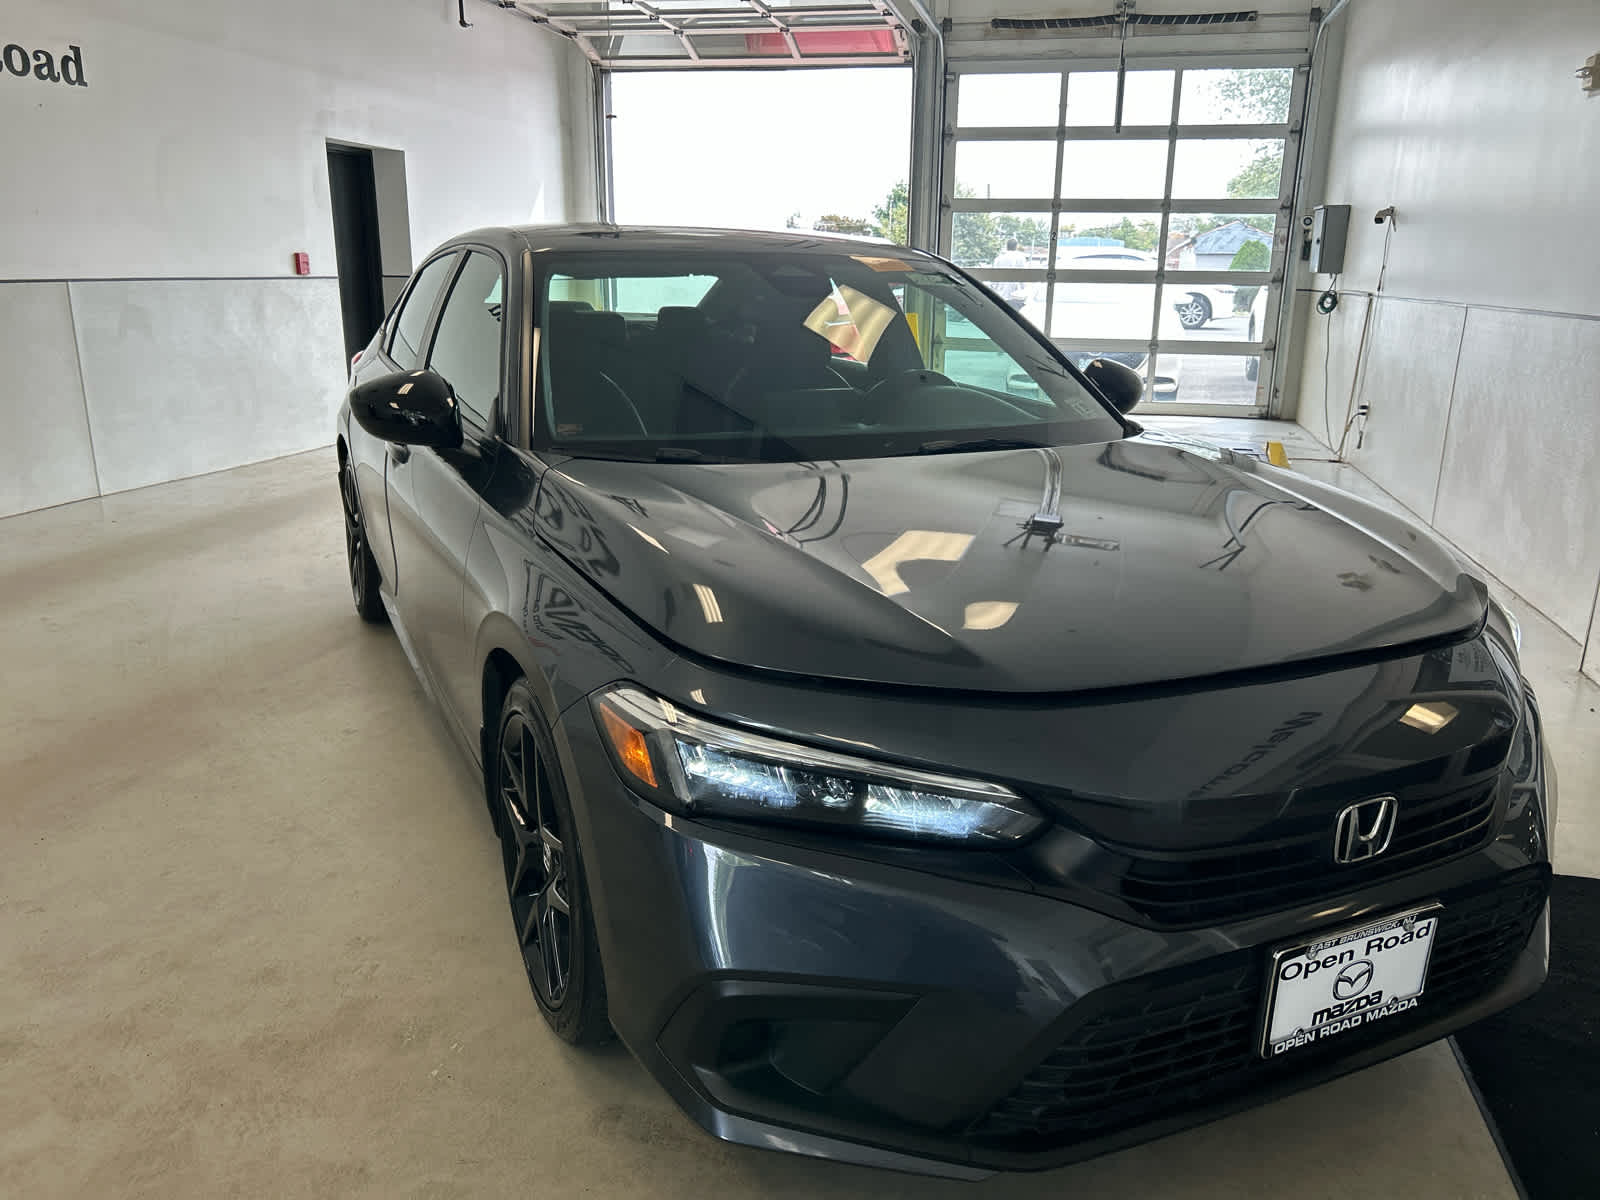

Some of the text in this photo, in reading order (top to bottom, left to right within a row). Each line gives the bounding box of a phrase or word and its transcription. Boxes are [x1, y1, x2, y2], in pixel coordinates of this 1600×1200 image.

[0, 44, 88, 87] oad
[1280, 921, 1432, 980] Open Road
[1310, 938, 1339, 953] EAST
[1274, 997, 1418, 1055] OPEN ROAD MAZDA
[1312, 990, 1383, 1026] mazda
